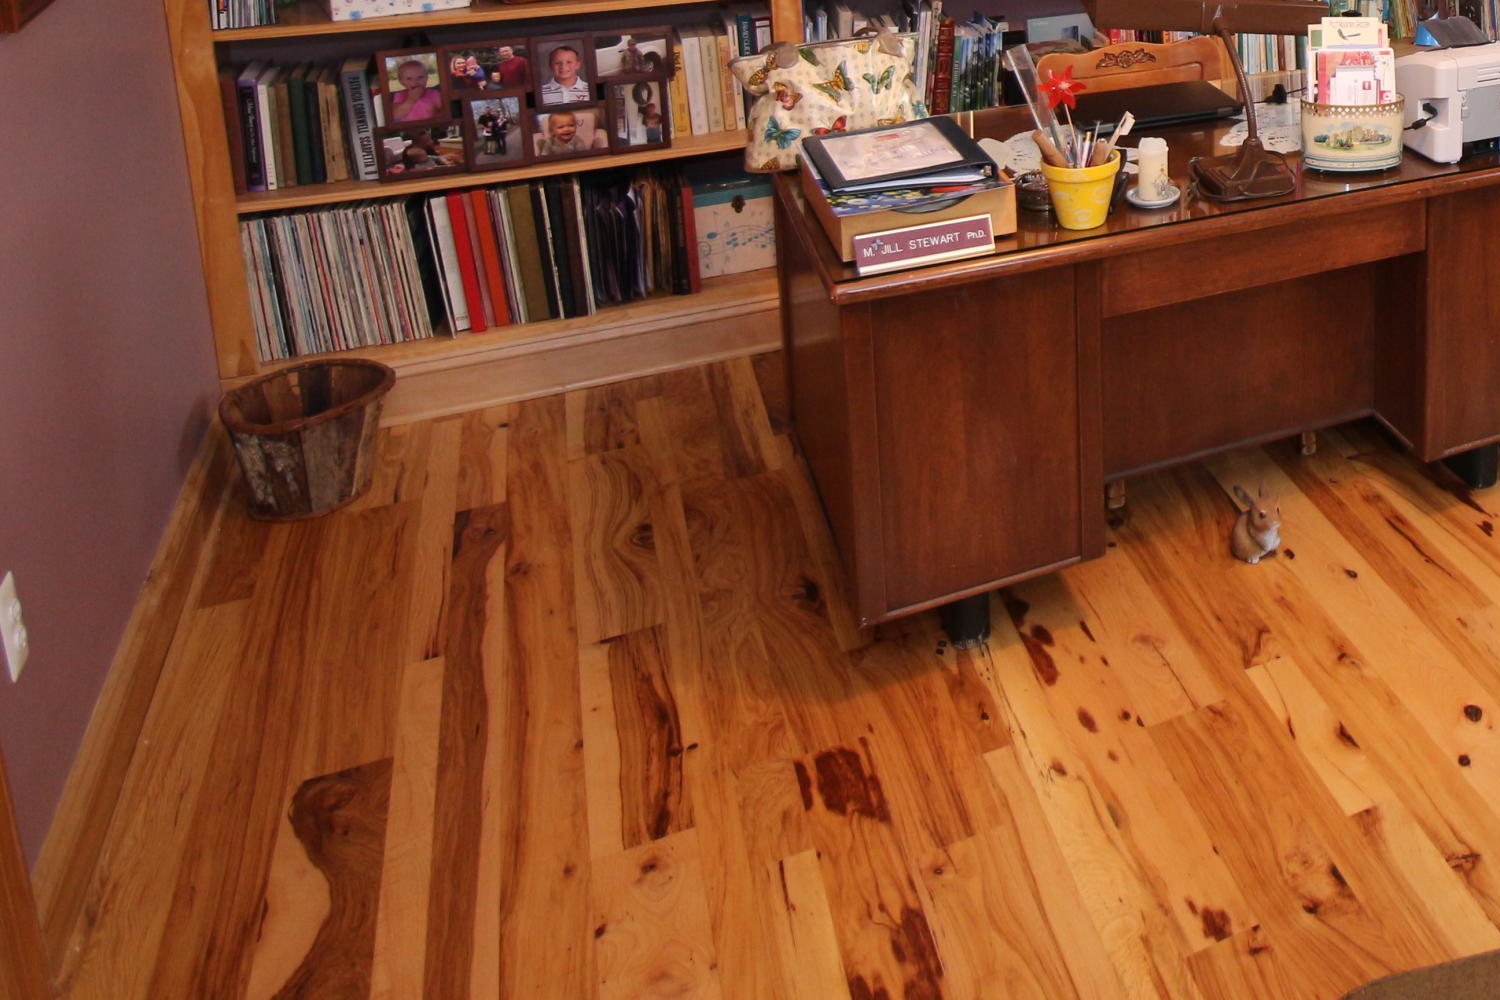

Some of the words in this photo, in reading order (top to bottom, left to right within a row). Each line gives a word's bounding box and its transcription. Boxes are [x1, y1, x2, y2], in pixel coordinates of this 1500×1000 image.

[348, 76, 362, 103] PATRICIA
[353, 103, 368, 134] CORNWELL
[359, 136, 375, 168] SCARPETTA
[863, 247, 876, 257] M.
[881, 243, 903, 255] JILL
[909, 232, 960, 250] STEWART
[966, 229, 987, 240] Ph.D.
